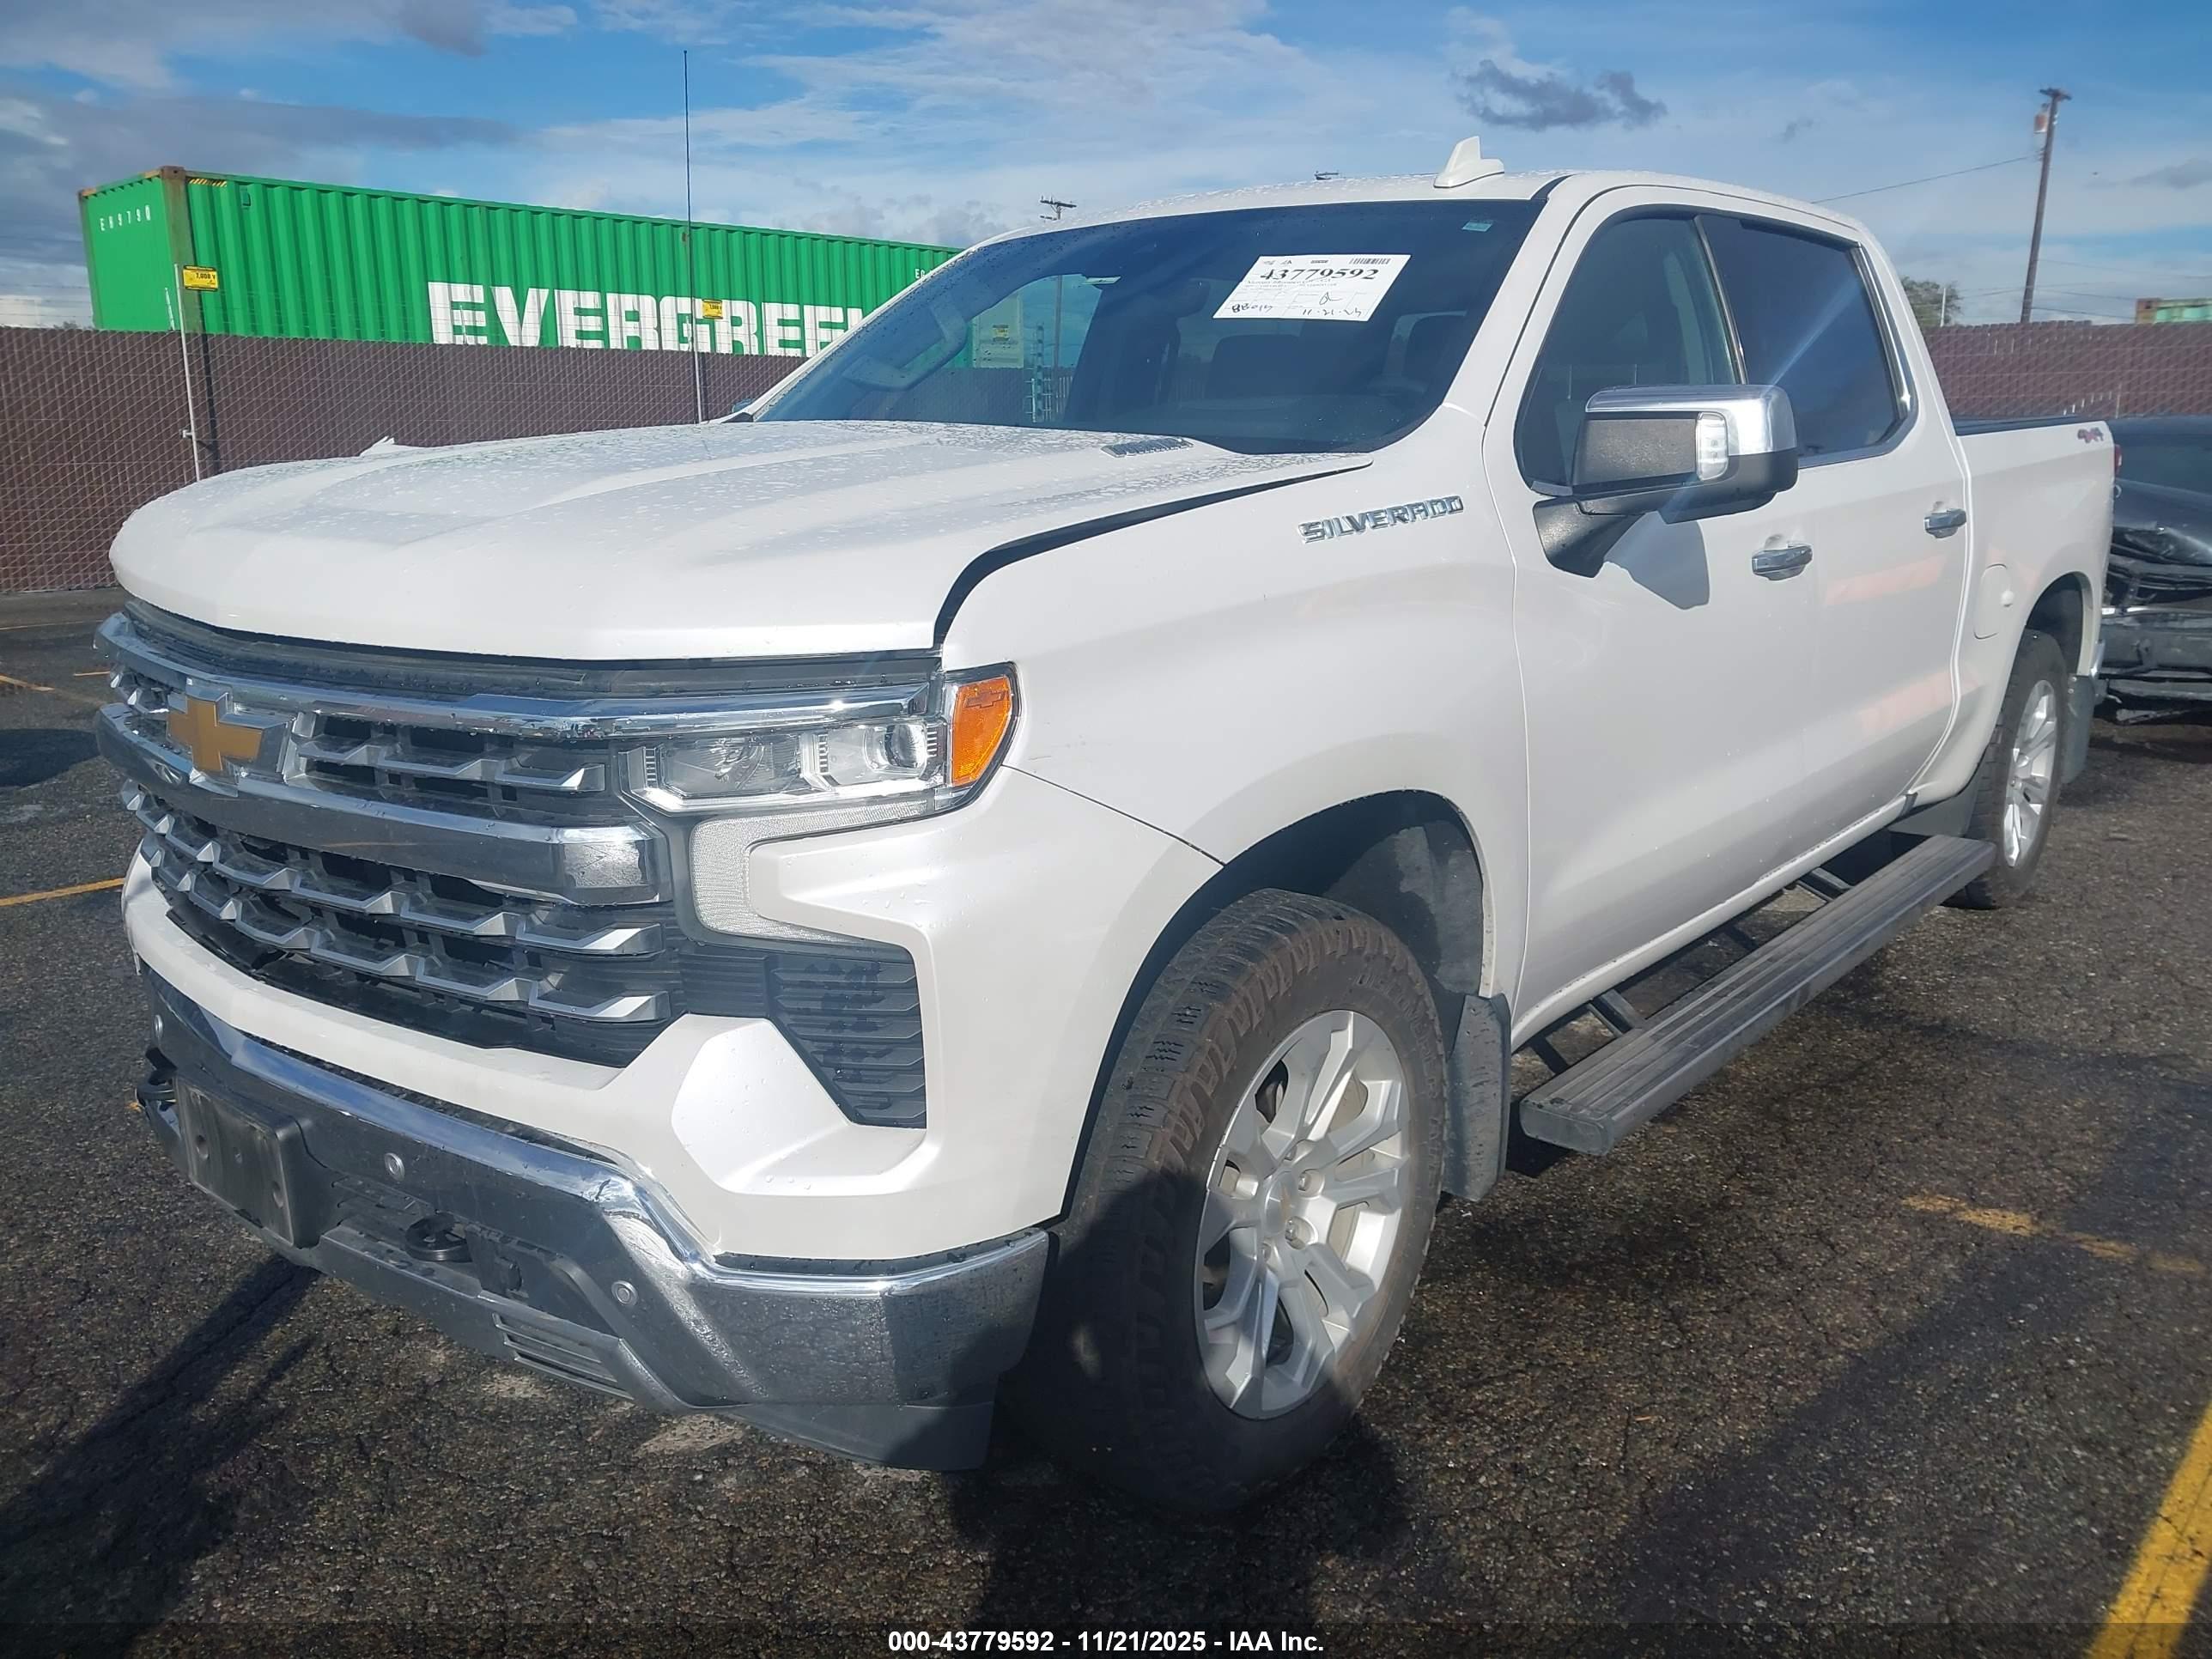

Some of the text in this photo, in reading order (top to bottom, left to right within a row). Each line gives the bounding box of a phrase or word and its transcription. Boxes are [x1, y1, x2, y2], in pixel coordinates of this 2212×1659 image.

[1260, 268, 1379, 281] 43779592
[428, 282, 863, 358] EVERGREE
[1297, 495, 1464, 544] SILVERADO
